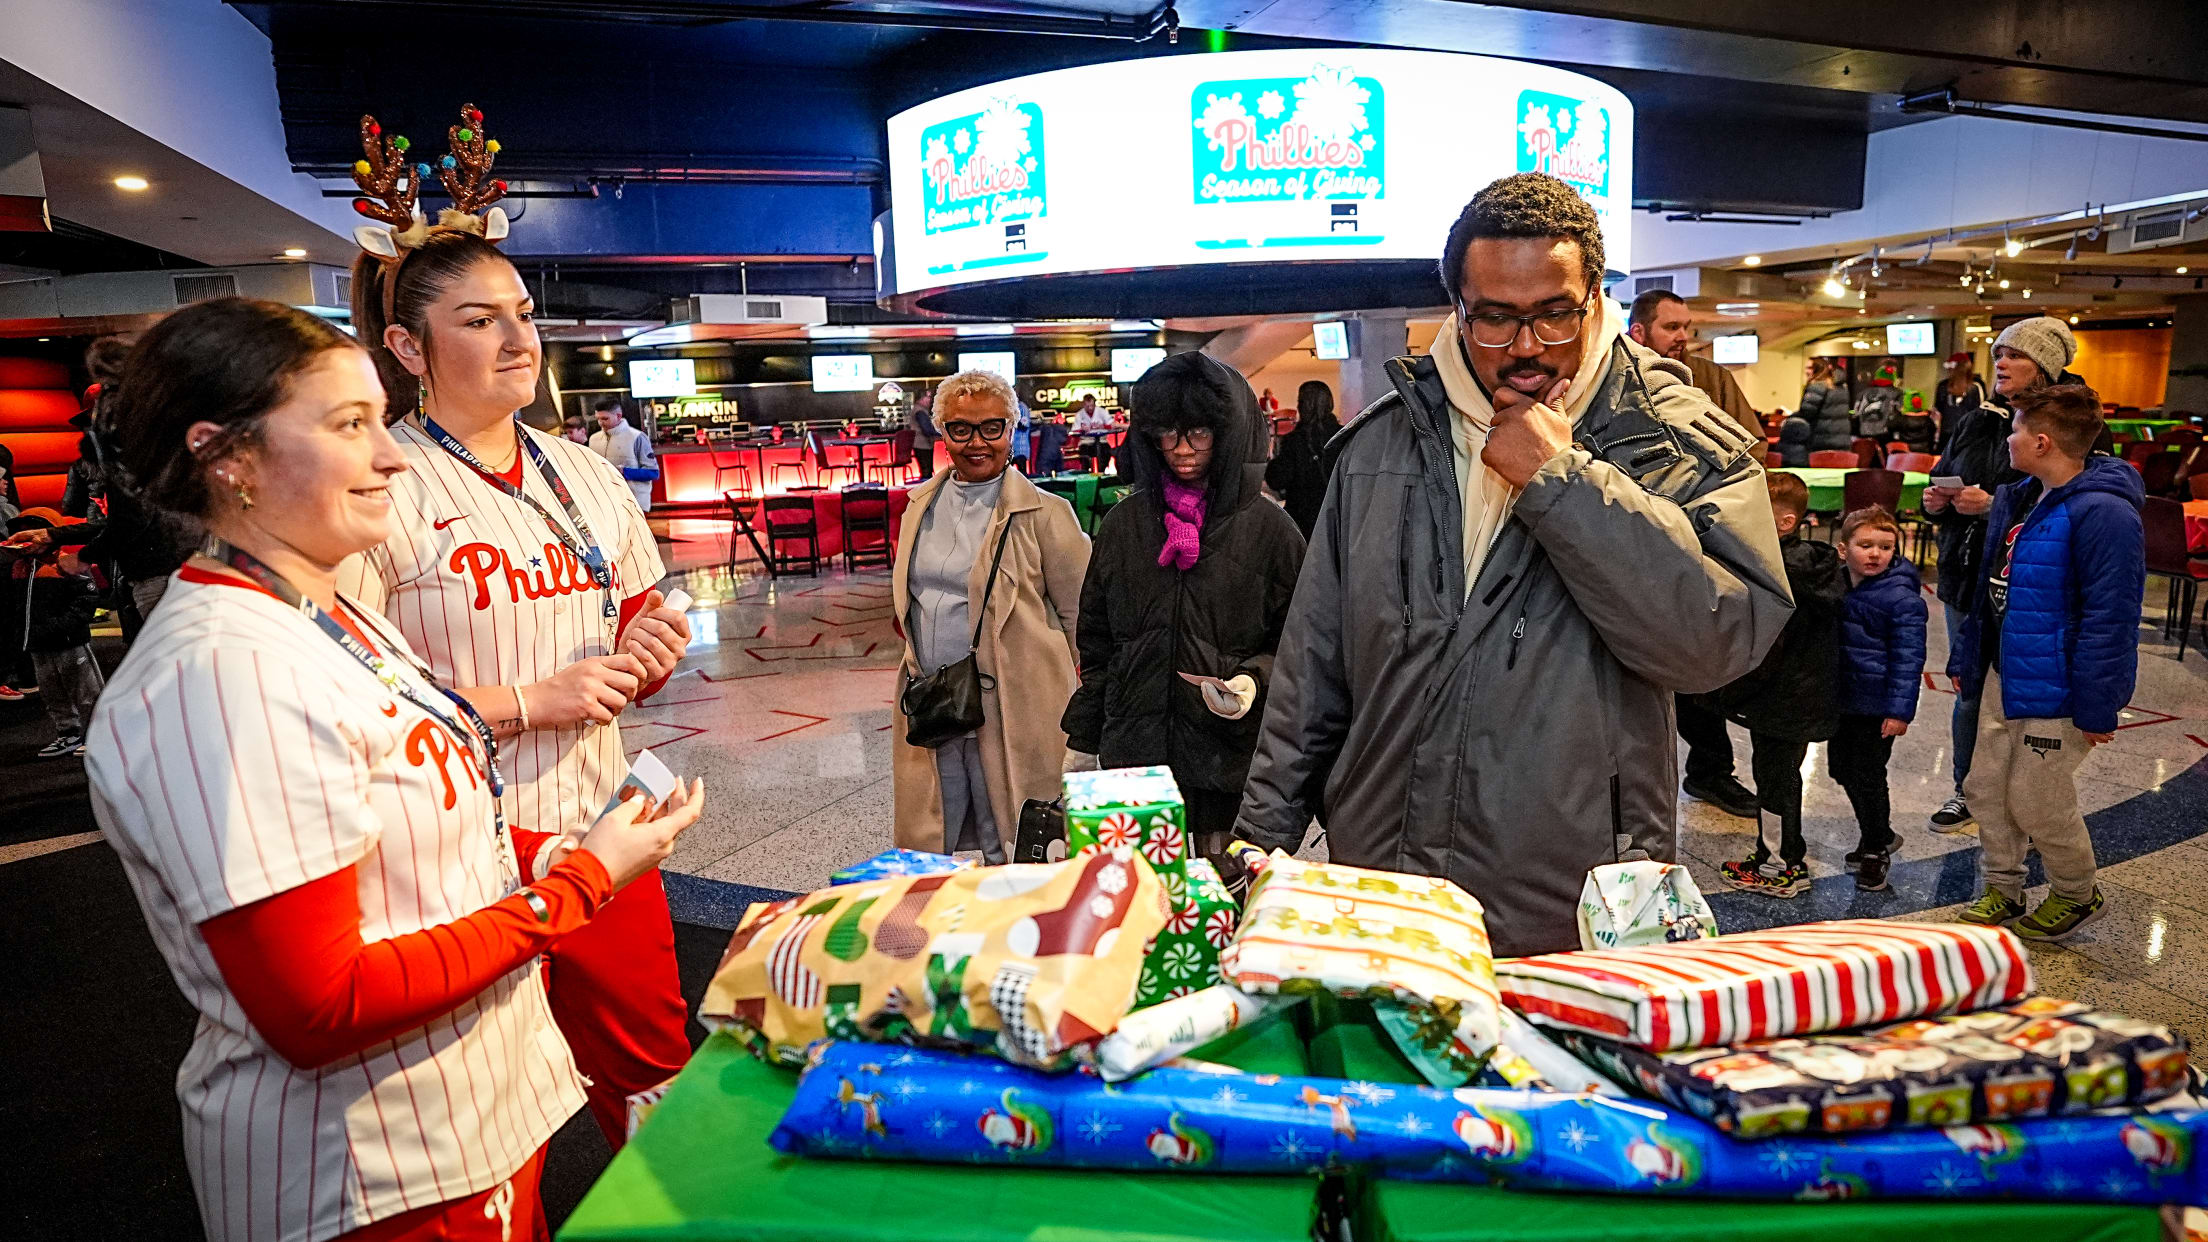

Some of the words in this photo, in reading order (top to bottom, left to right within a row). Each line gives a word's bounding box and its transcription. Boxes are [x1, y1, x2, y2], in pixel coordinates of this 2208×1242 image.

[1212, 118, 1362, 169] Phillies
[931, 156, 1027, 203] Phillies
[1200, 172, 1282, 199] Season
[1284, 170, 1309, 201] of
[1310, 168, 1383, 201] Giving
[1035, 388, 1059, 403] CP
